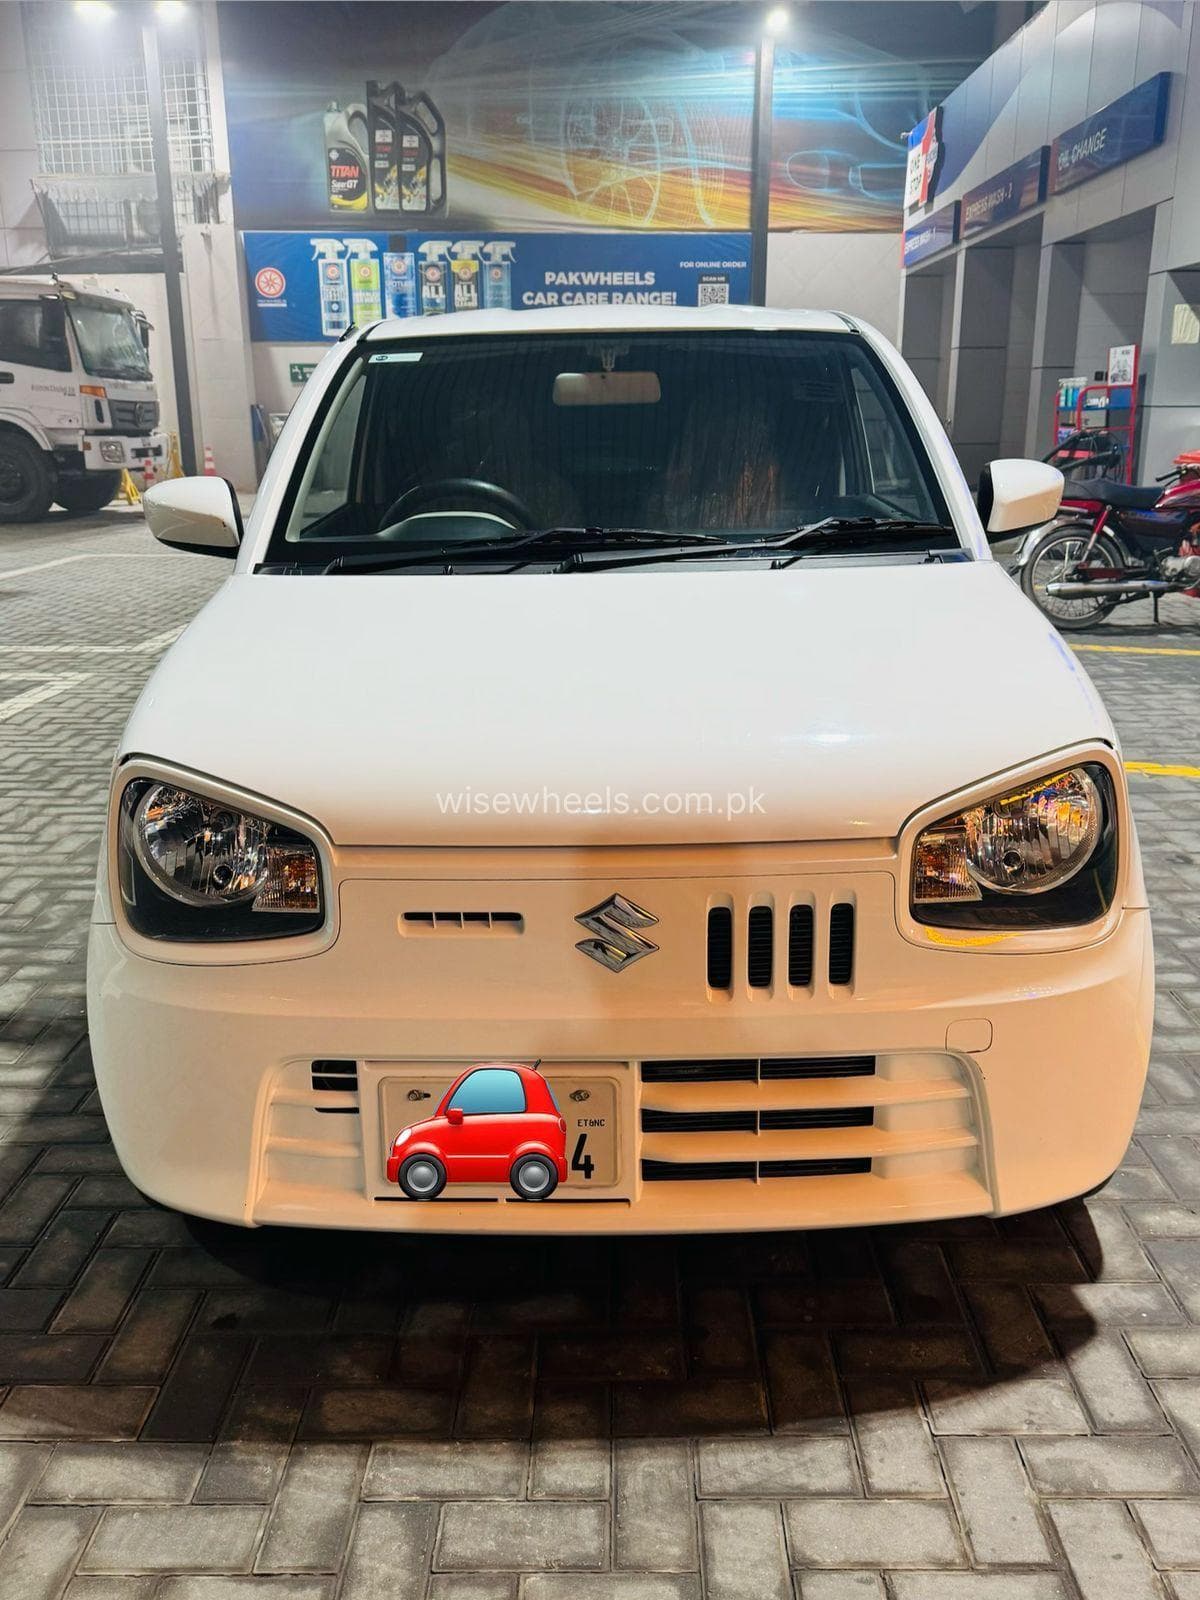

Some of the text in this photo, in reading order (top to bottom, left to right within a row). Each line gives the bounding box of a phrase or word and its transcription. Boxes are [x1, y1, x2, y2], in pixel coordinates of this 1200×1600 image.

[1071, 127, 1107, 164] CHANGE
[331, 165, 359, 178] TITAN
[680, 261, 695, 269] FOR
[544, 271, 656, 286] PAKWHEELS
[422, 285, 446, 298] ALL
[522, 291, 677, 306] CAR CARE RANGE!
[577, 1118, 605, 1127] ET&NC
[571, 1133, 595, 1179] 4
